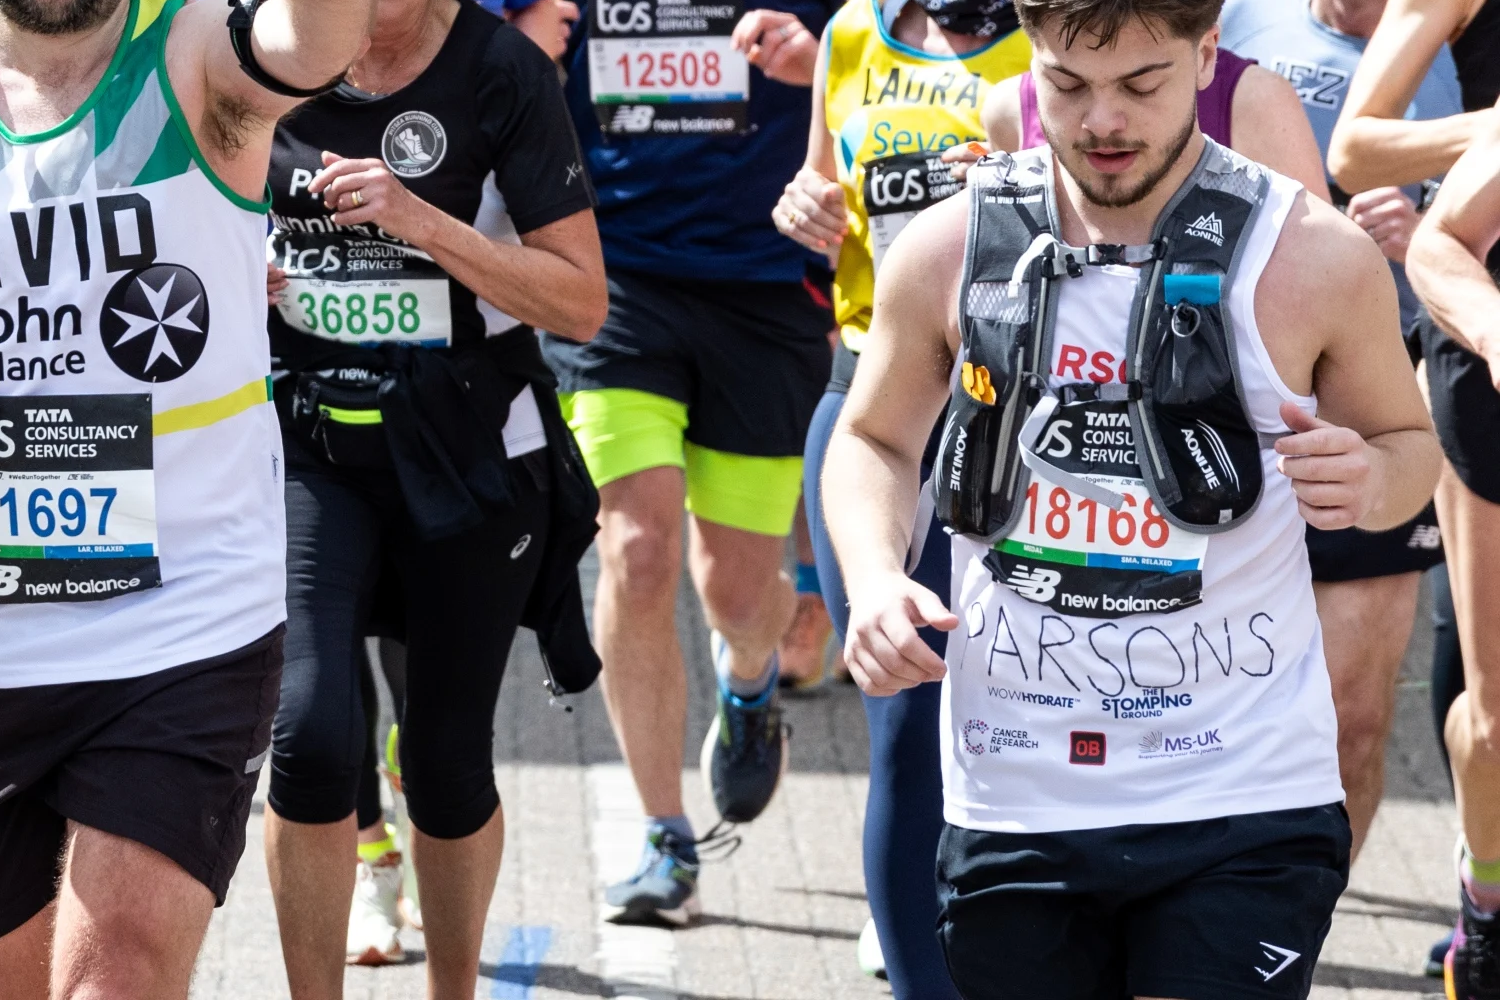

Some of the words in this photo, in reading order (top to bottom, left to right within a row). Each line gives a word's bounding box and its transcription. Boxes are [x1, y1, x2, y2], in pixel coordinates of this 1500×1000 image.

[655, 5, 735, 19] CONSULTANCY
[655, 18, 708, 31] SERVICES
[617, 51, 721, 88] 12508
[862, 68, 981, 108] LAURA
[653, 119, 679, 132] new
[680, 116, 735, 132] balance
[870, 166, 925, 206] tcs
[1184, 228, 1224, 247] AONIJIE
[284, 241, 341, 275] tcs
[346, 259, 403, 272] SERVICES
[296, 292, 421, 335] 36858
[339, 368, 368, 380] new
[24, 409, 73, 422] TATA
[24, 425, 138, 441] CONSULTANCY
[25, 444, 97, 458] SERVICES
[950, 425, 968, 492] AONIJIE
[1181, 428, 1221, 490] AONIJIE
[8, 473, 61, 481] #WeRunTogether
[1025, 481, 1170, 548] 18168
[1121, 557, 1139, 565] SMA,
[1141, 557, 1173, 567] RELAXED
[25, 581, 61, 596] new
[66, 577, 141, 594] balance
[1061, 592, 1099, 609] new
[960, 602, 1275, 697] PARSONS
[1142, 688, 1158, 696] THE
[1102, 687, 1192, 719] STOMPING
[1120, 710, 1163, 719] GROUND
[993, 728, 1028, 739] CANCER
[1165, 728, 1222, 752] MS-UK
[990, 736, 1039, 749] RESEARCH
[990, 746, 1001, 754] UK
[1075, 740, 1101, 756] OB
[1200, 746, 1223, 755] journey
